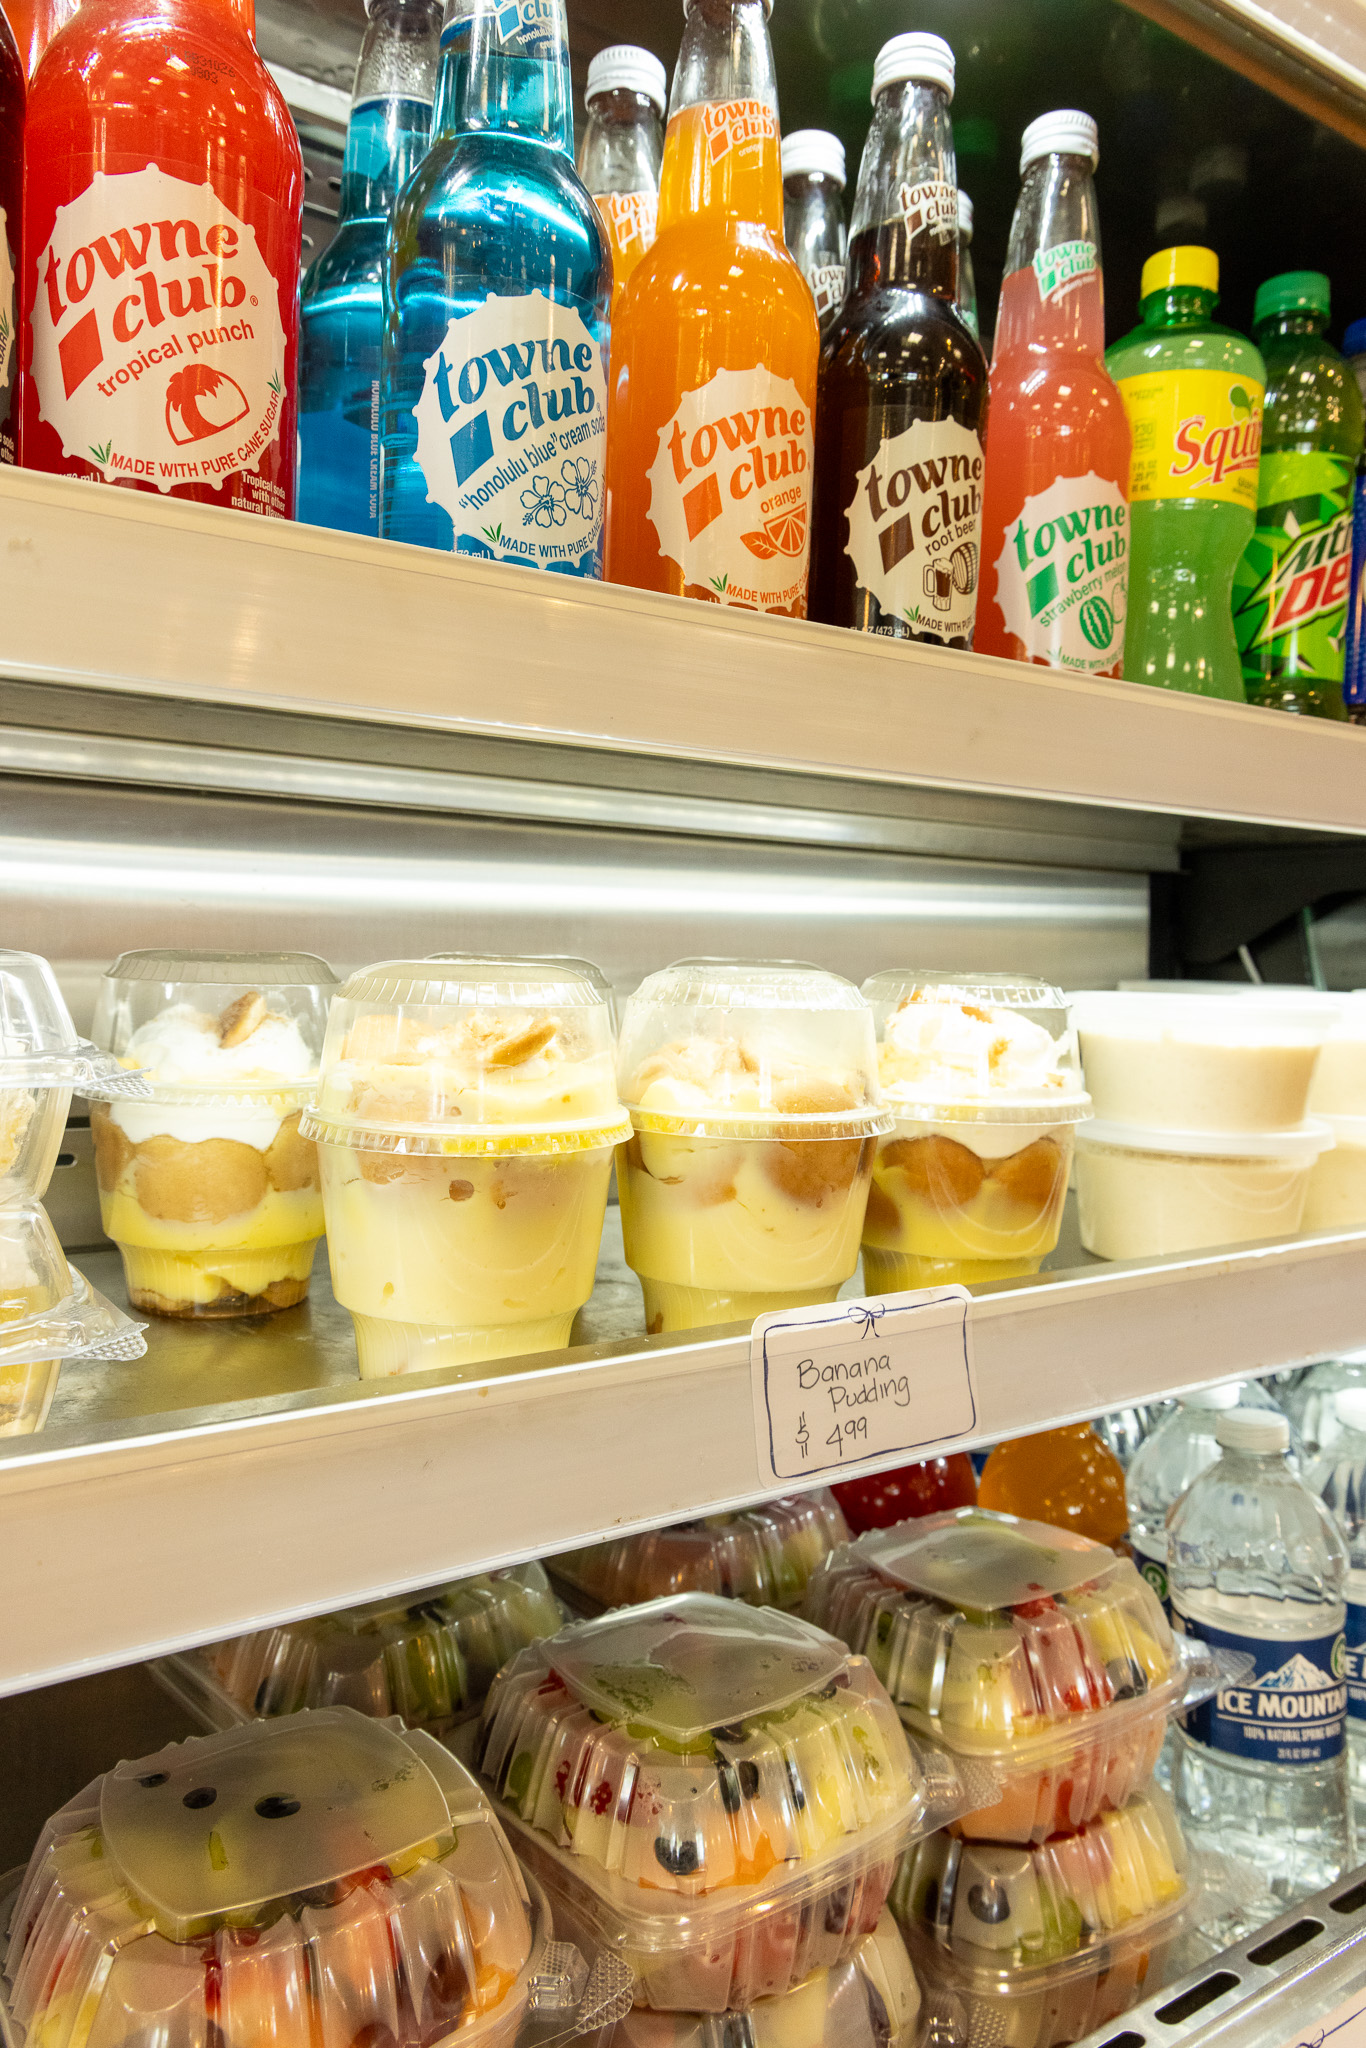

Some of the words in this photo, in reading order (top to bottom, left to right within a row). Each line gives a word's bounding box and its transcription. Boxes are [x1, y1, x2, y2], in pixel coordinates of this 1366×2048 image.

[704, 101, 773, 135] towne
[731, 117, 774, 143] club
[738, 143, 763, 157] orange
[900, 182, 957, 212] towne
[926, 200, 957, 221] club
[44, 219, 239, 327] towne
[1036, 243, 1094, 274] towne
[1061, 256, 1095, 278] club
[112, 263, 247, 343] club
[97, 334, 184, 398] tropical
[187, 319, 255, 354] punch
[433, 338, 593, 423] towne
[502, 376, 596, 441] club
[110, 452, 155, 476] MADE
[159, 462, 199, 478] WITH
[200, 452, 239, 476] PURE
[237, 431, 265, 462] CANE
[259, 391, 280, 437] SUGAR
[559, 422, 592, 451] cream
[591, 410, 606, 434] soda
[667, 406, 806, 485] towne
[241, 470, 273, 493] Tropical
[729, 439, 807, 501] club
[864, 454, 982, 523] towne
[231, 496, 264, 515] natural
[251, 489, 270, 504] with
[760, 486, 802, 514] orange
[921, 484, 981, 539] club
[499, 535, 536, 556] MADE
[538, 544, 567, 558] WITH
[568, 536, 589, 556] PURE
[587, 519, 601, 544] CANE
[925, 529, 954, 556] root
[954, 519, 976, 538] beer
[1013, 504, 1126, 572] towne
[1066, 531, 1127, 584] club
[726, 583, 758, 603] MADE
[759, 590, 782, 604] WITH
[783, 583, 800, 603] PURE
[1040, 575, 1103, 628] strawberry
[1272, 552, 1352, 630] DE
[916, 614, 943, 631] MADE
[944, 621, 962, 633] WITH
[1061, 654, 1087, 670] MADE
[797, 1354, 892, 1390] Banana
[827, 1375, 911, 1413] Pudding
[1216, 1690, 1253, 1715] ICE
[1257, 1684, 1348, 1719] MOUNTA
